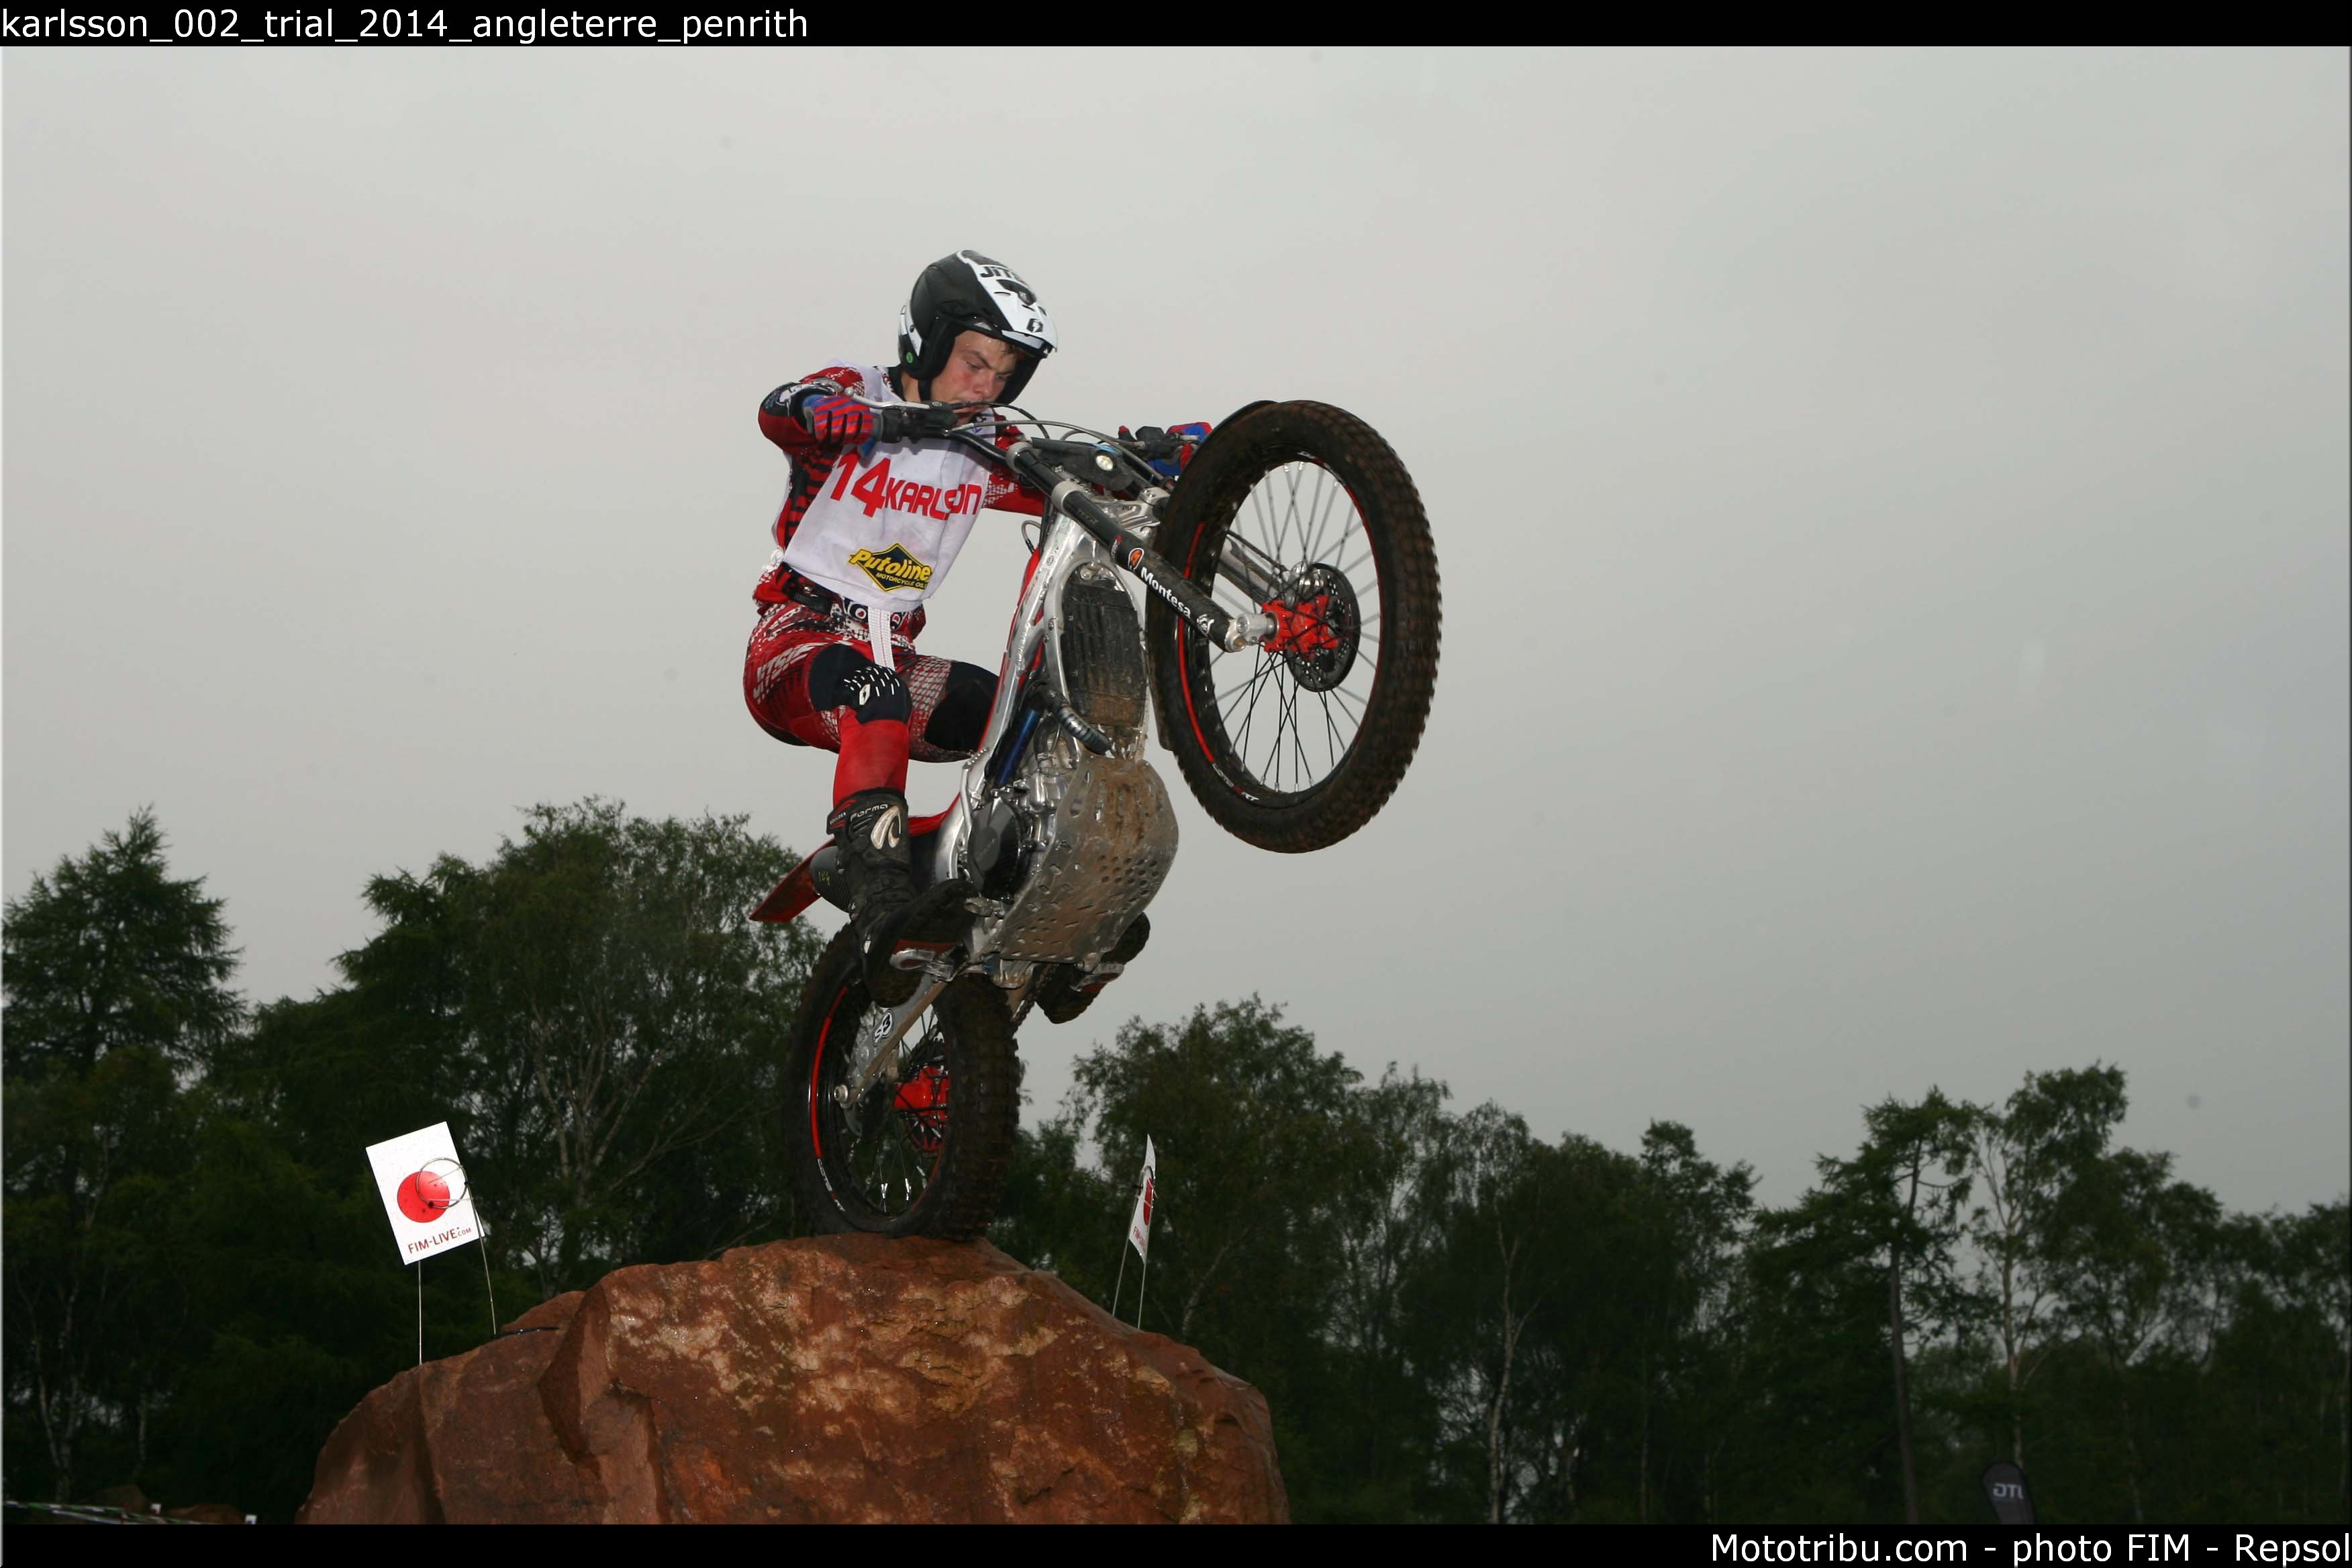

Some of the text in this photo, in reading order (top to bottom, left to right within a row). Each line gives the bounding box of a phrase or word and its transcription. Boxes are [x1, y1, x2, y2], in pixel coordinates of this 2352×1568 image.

[830, 452, 891, 518] 14
[848, 549, 932, 582] Putoline
[875, 572, 914, 587] MOTORCYCLE
[1140, 567, 1191, 619] Montesa
